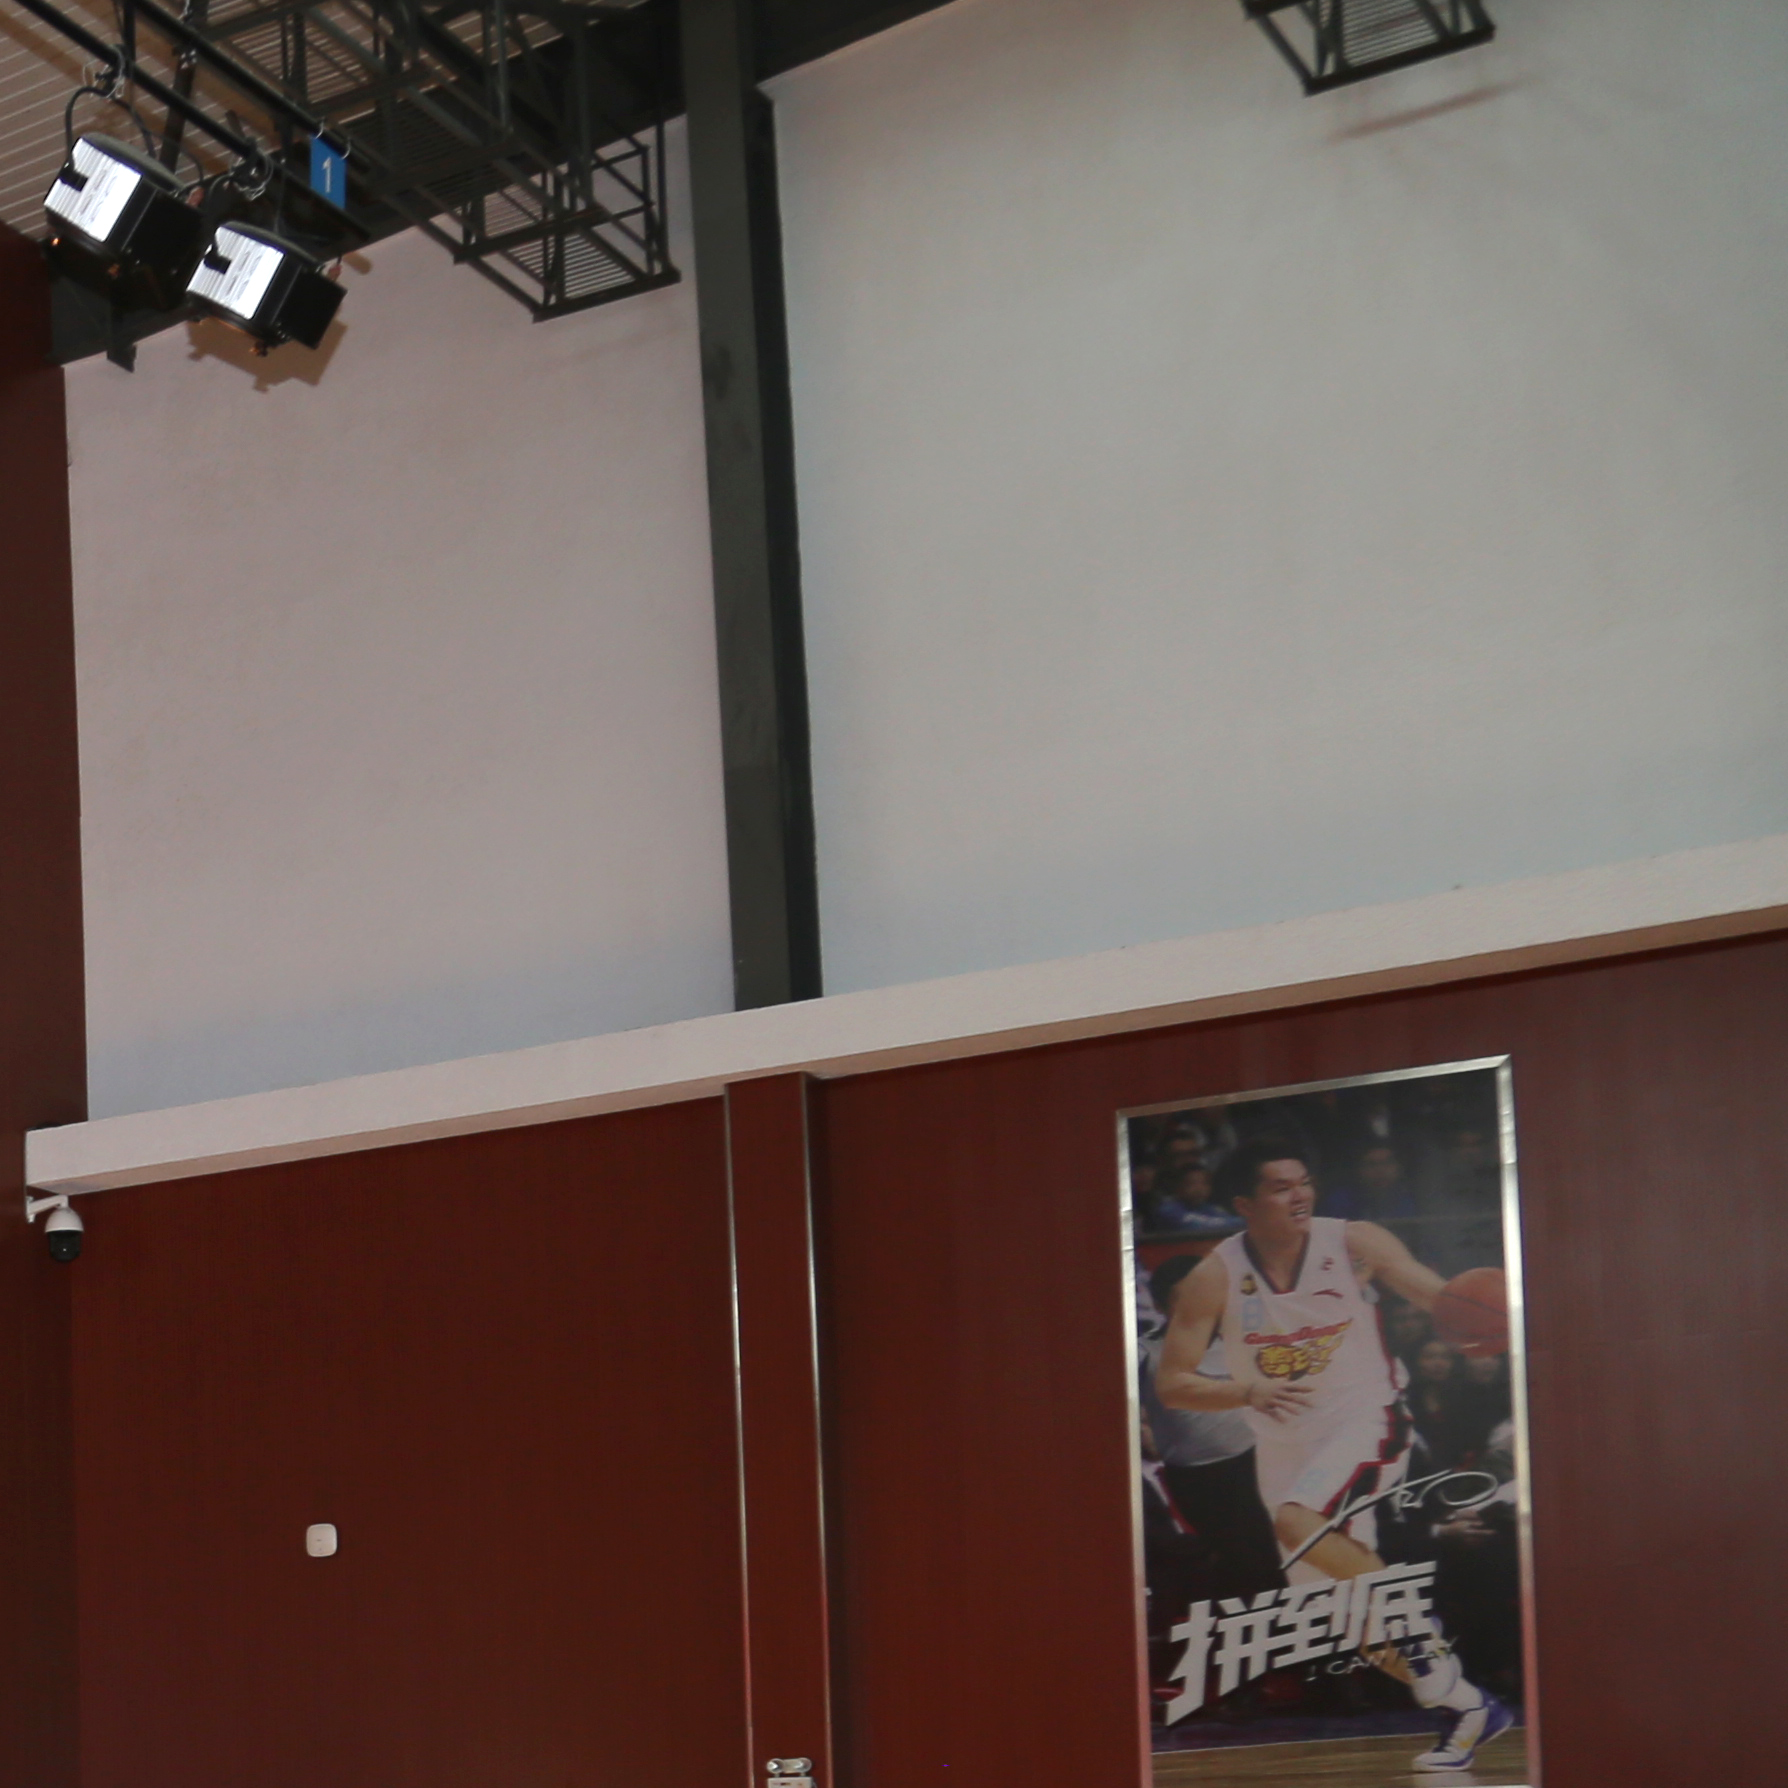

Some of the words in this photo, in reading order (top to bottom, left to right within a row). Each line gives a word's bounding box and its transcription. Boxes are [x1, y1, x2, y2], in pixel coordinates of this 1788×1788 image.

[322, 156, 332, 194] 1
[1165, 1560, 1437, 1727] 拼到底
